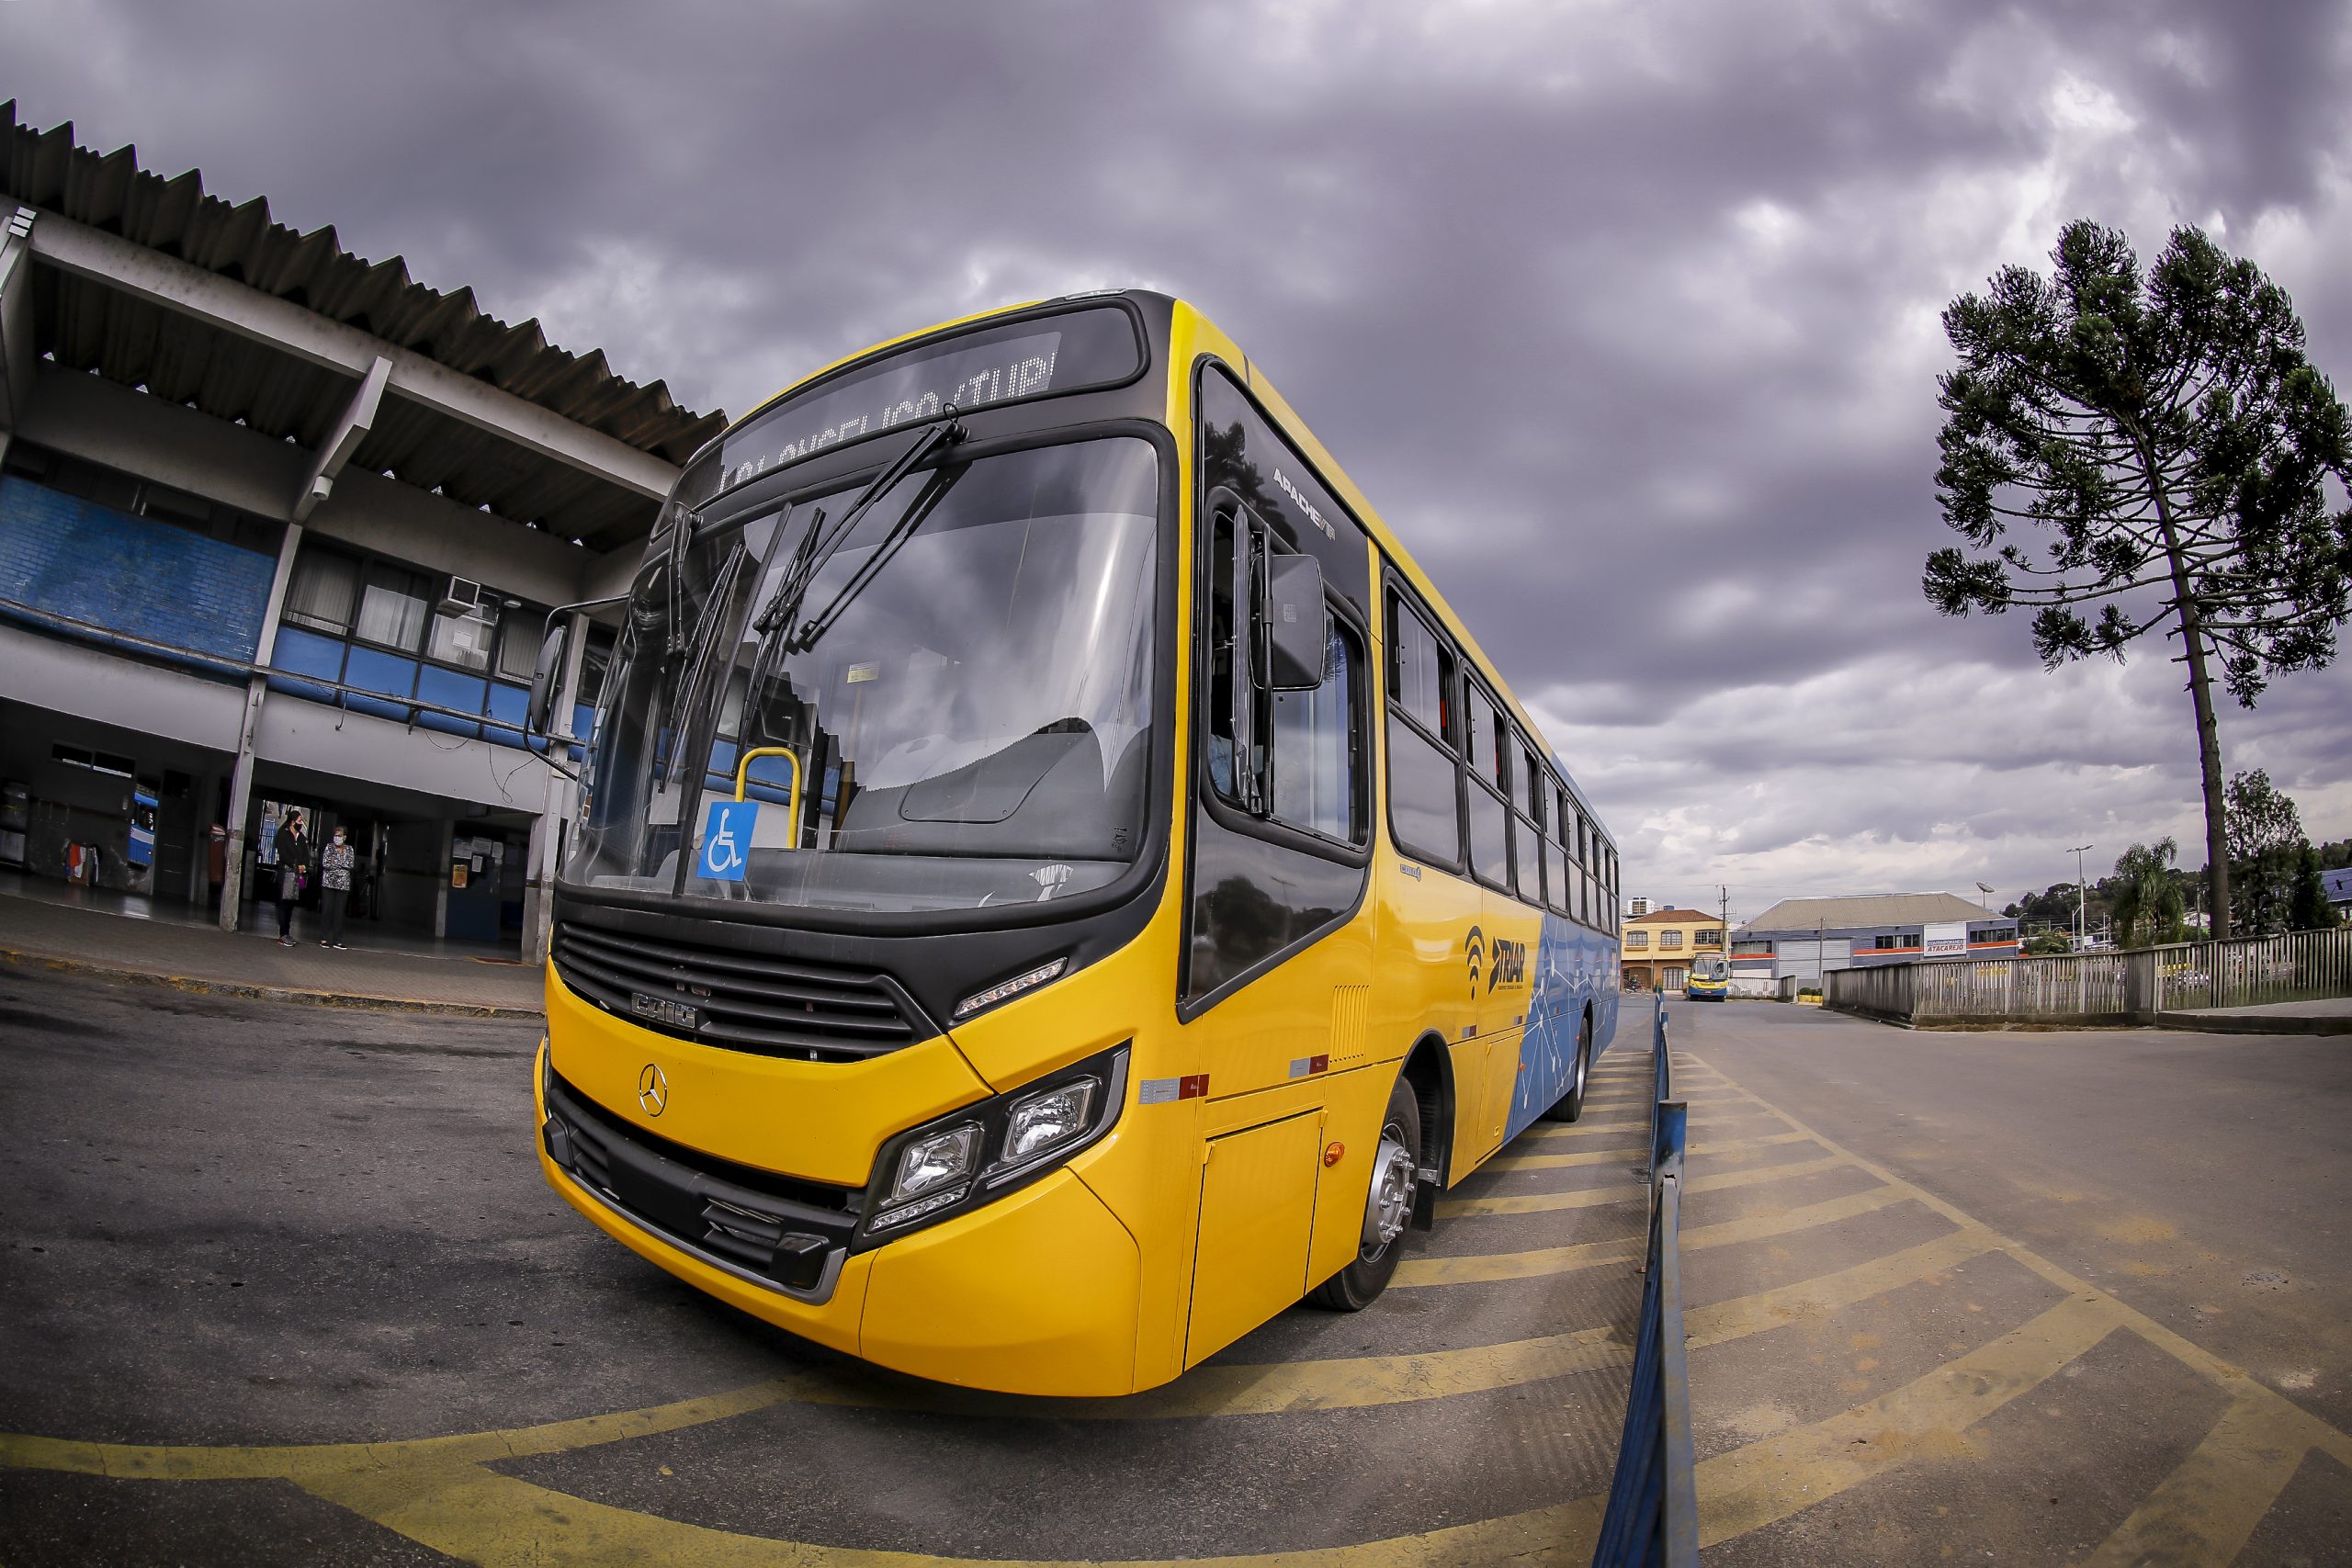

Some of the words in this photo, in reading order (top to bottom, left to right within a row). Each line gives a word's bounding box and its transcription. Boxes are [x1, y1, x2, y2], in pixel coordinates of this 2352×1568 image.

[1272, 467, 1323, 531] APACHE
[1497, 938, 1526, 983] TRIAR
[1927, 944, 1964, 953] ATACAREJO
[632, 992, 696, 1029] CAIO
